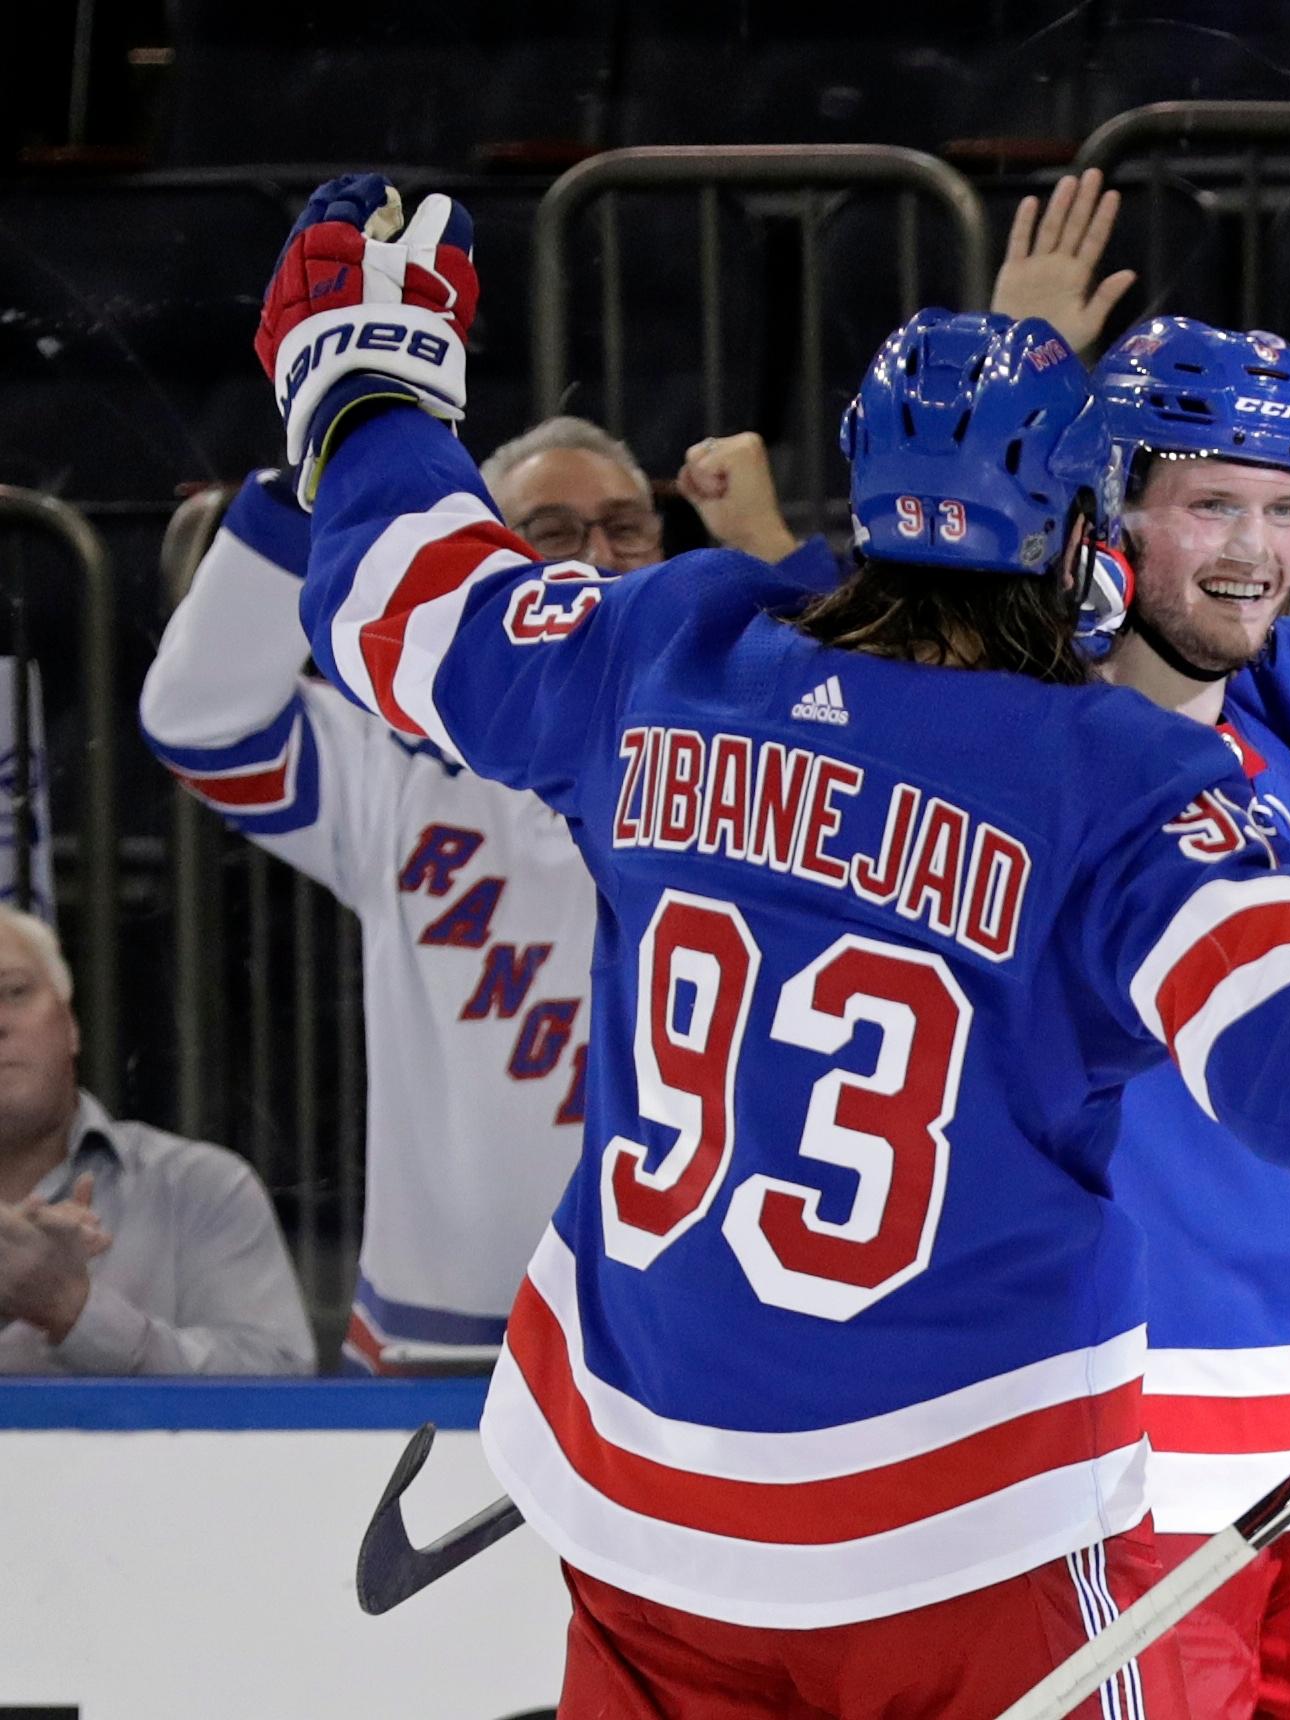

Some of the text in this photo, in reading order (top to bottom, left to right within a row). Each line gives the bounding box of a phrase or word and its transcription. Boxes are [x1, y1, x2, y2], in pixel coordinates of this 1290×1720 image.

[896, 495, 967, 542] 93
[791, 702, 849, 726] adidas
[612, 726, 1032, 962] ZIBANEJAD
[600, 887, 974, 1323] 93
